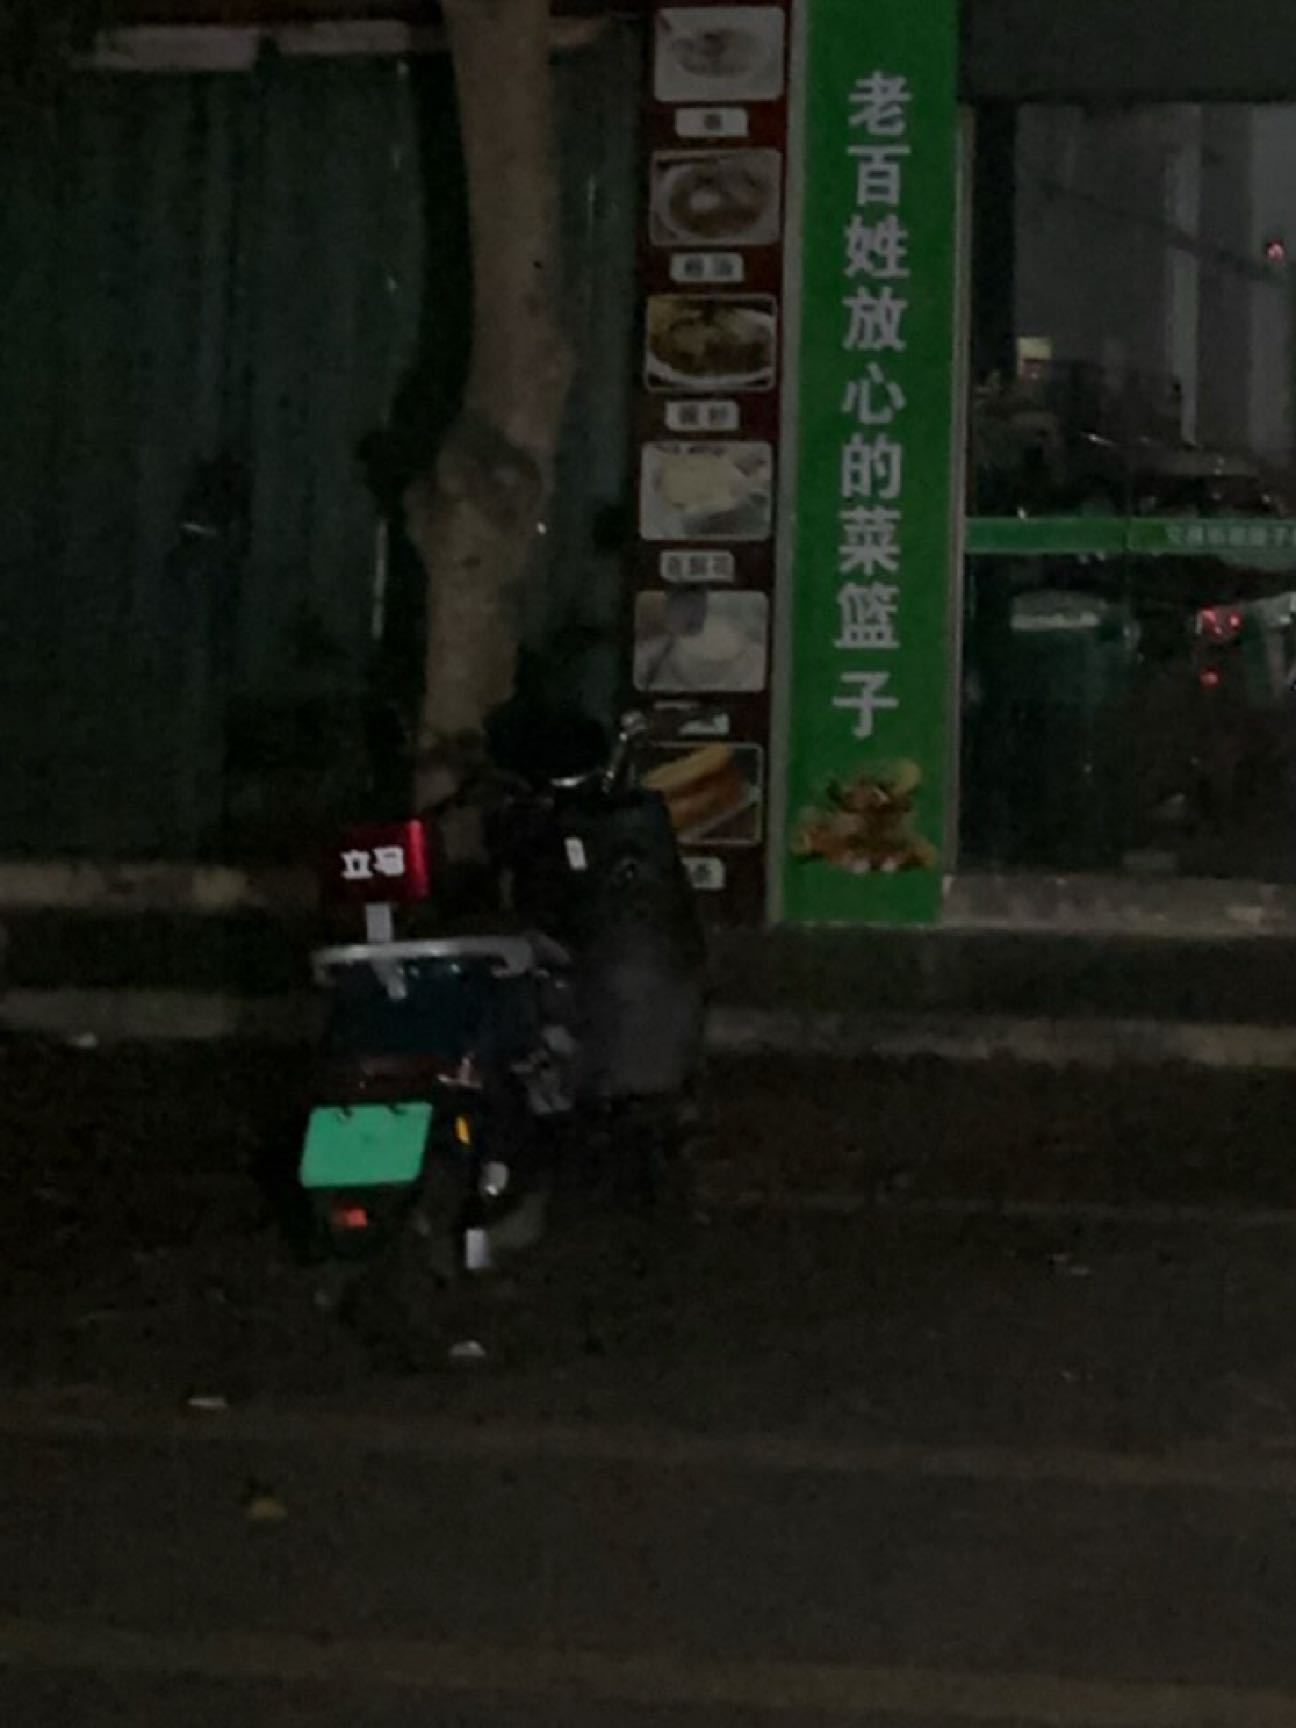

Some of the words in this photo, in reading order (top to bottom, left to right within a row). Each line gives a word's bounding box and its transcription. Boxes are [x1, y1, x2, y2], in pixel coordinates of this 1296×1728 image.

[832, 70, 914, 739] 老百姓放心的菜篮子
